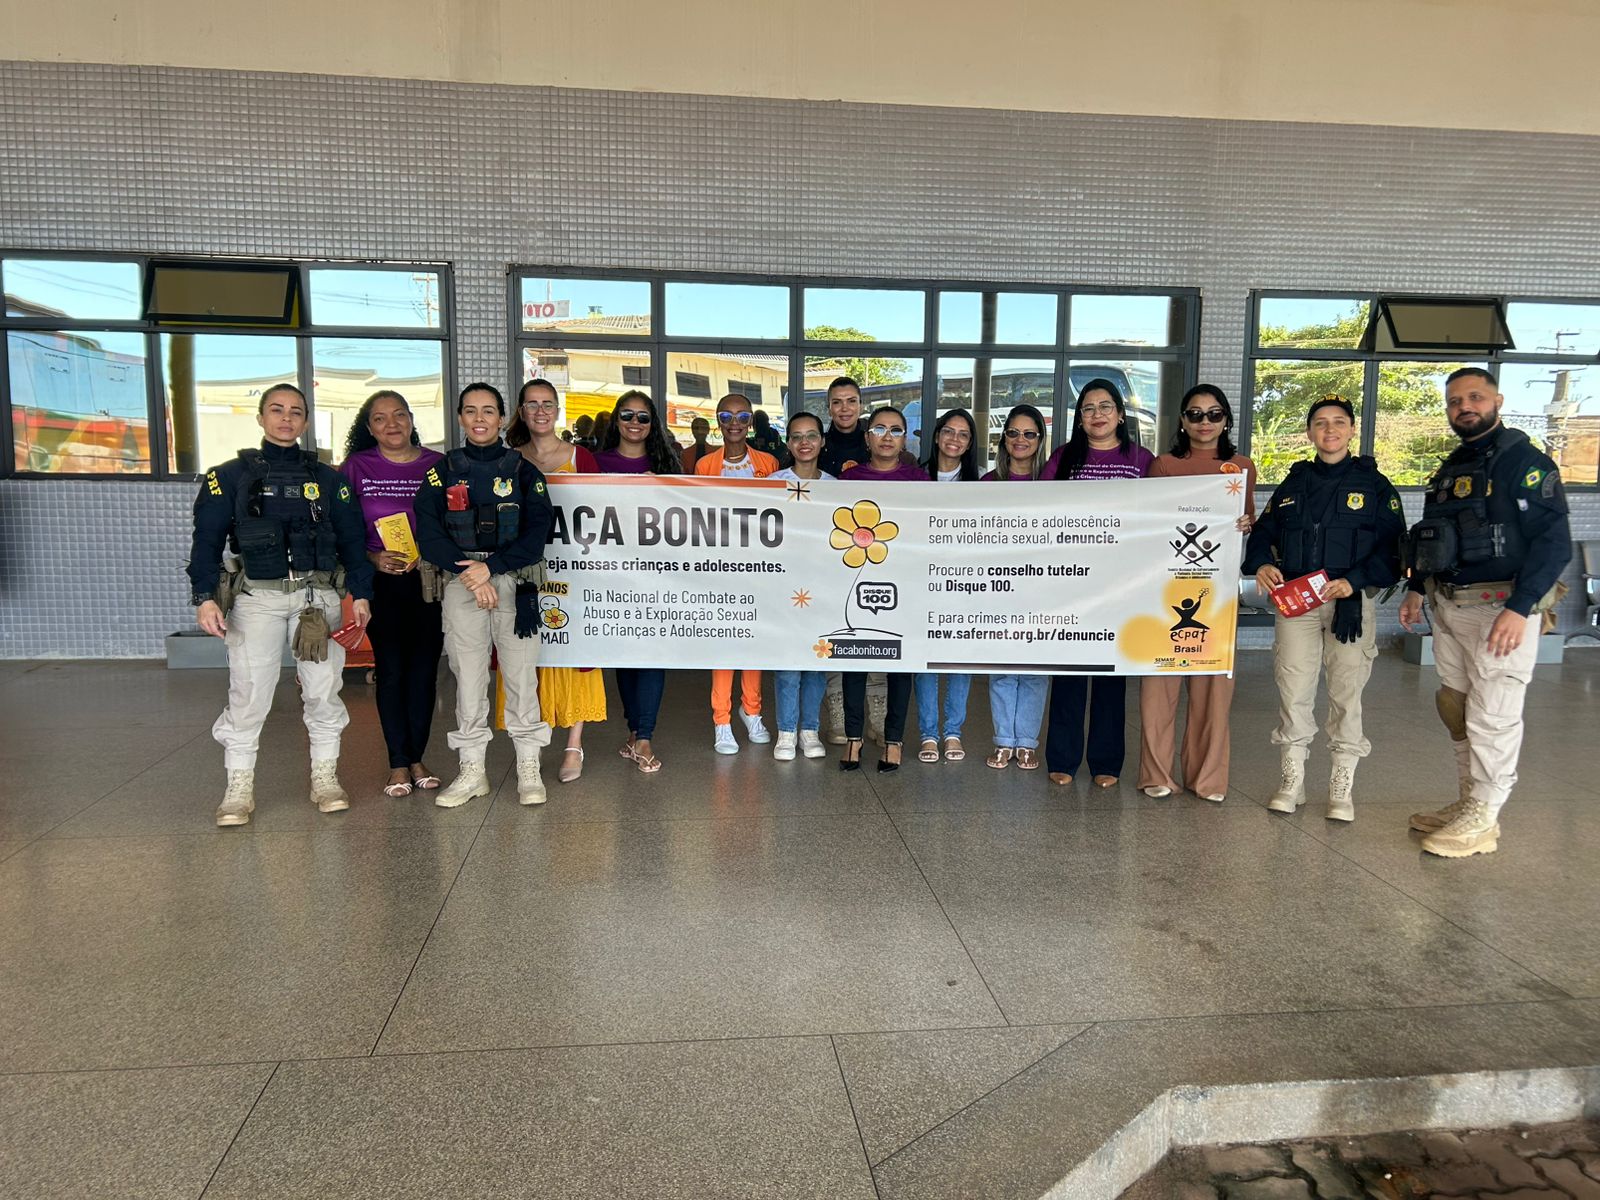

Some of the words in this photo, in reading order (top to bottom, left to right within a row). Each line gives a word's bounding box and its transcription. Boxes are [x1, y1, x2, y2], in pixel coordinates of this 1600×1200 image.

[207, 470, 222, 495] PRF
[426, 467, 443, 487] PRF
[638, 506, 784, 548] BONITO
[928, 515, 949, 528] Por
[951, 518, 977, 528] uma
[980, 515, 1028, 528] infância
[1031, 518, 1039, 528] e
[1042, 514, 1121, 528] adolescência
[928, 533, 953, 544] sem
[956, 531, 1008, 544] violência
[1012, 531, 1053, 545] sexual,
[1056, 530, 1119, 544] denuncie.
[571, 560, 619, 571] nossas
[621, 556, 679, 574] crianças
[682, 561, 690, 572] e
[694, 559, 786, 573] adolescentes.
[928, 563, 974, 576] Procure
[977, 566, 985, 576] o
[987, 563, 1044, 576] conselho
[1047, 563, 1091, 576] tutelar
[540, 582, 568, 594] ANOS
[928, 582, 942, 592] ou
[945, 579, 987, 595] Disque
[990, 579, 1015, 592] 100.
[583, 589, 602, 603] Dia
[606, 589, 659, 604] Nacional
[662, 590, 678, 604] de
[681, 590, 736, 604] Combate
[740, 593, 755, 605] ao
[862, 594, 891, 604] 100
[583, 606, 620, 620] Abuso
[624, 609, 631, 620] e
[634, 607, 642, 620] à
[646, 607, 713, 624] Exploração
[717, 607, 757, 621] Sexual
[928, 611, 935, 624] E
[938, 613, 964, 626] para
[967, 611, 1007, 624] crimes
[1010, 614, 1025, 625] na
[1028, 611, 1079, 625] internet:
[541, 631, 570, 645] MAIO
[584, 623, 599, 637] de
[602, 623, 656, 639] Crianças
[659, 626, 667, 637] e
[670, 624, 755, 638] Adolescentes.
[927, 627, 1115, 643] new.safernet.org.br/denuncie
[834, 644, 898, 658] facabonito.org
[1174, 645, 1202, 653] Brasil
